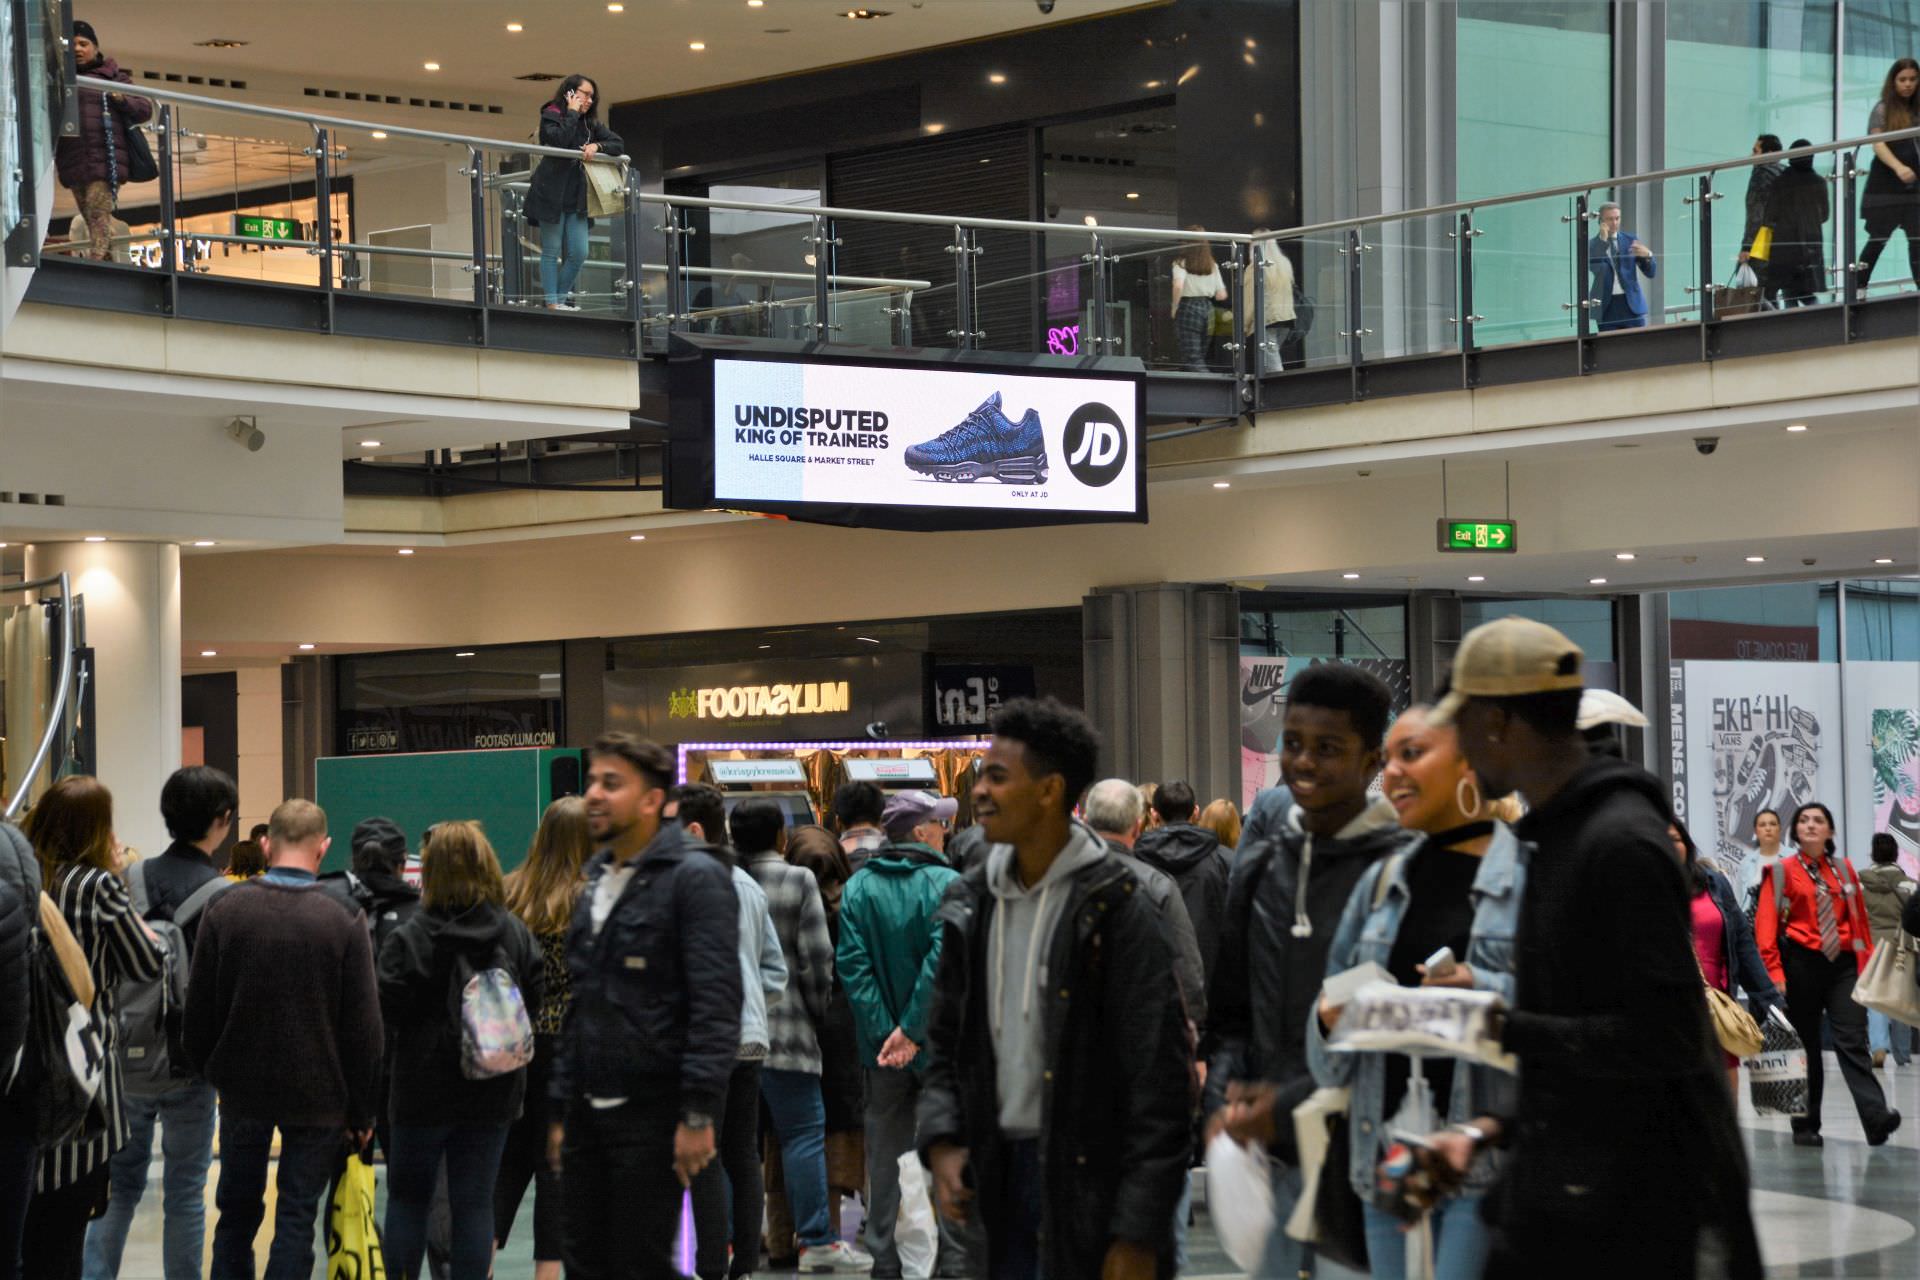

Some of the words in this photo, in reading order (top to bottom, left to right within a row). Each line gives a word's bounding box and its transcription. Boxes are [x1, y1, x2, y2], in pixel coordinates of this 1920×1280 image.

[244, 223, 259, 232] Exit
[735, 405, 889, 432] UNDISPUTED
[735, 428, 775, 445] KING
[780, 430, 802, 445] OF
[807, 431, 889, 449] TRAINERS
[1070, 422, 1120, 466] JD
[749, 454, 774, 462] HALLE
[775, 455, 806, 464] SQUARE
[814, 456, 845, 465] MARKET
[847, 457, 875, 466] STREET
[1011, 490, 1028, 498] ONLY
[1455, 530, 1471, 541] Exit
[1250, 664, 1284, 687] NIKE
[697, 681, 849, 719] FOOTASYLUM
[475, 732, 555, 748] FOOTASYLUM.COM
[1670, 703, 1685, 775] MENS
[1719, 733, 1743, 746] VANS
